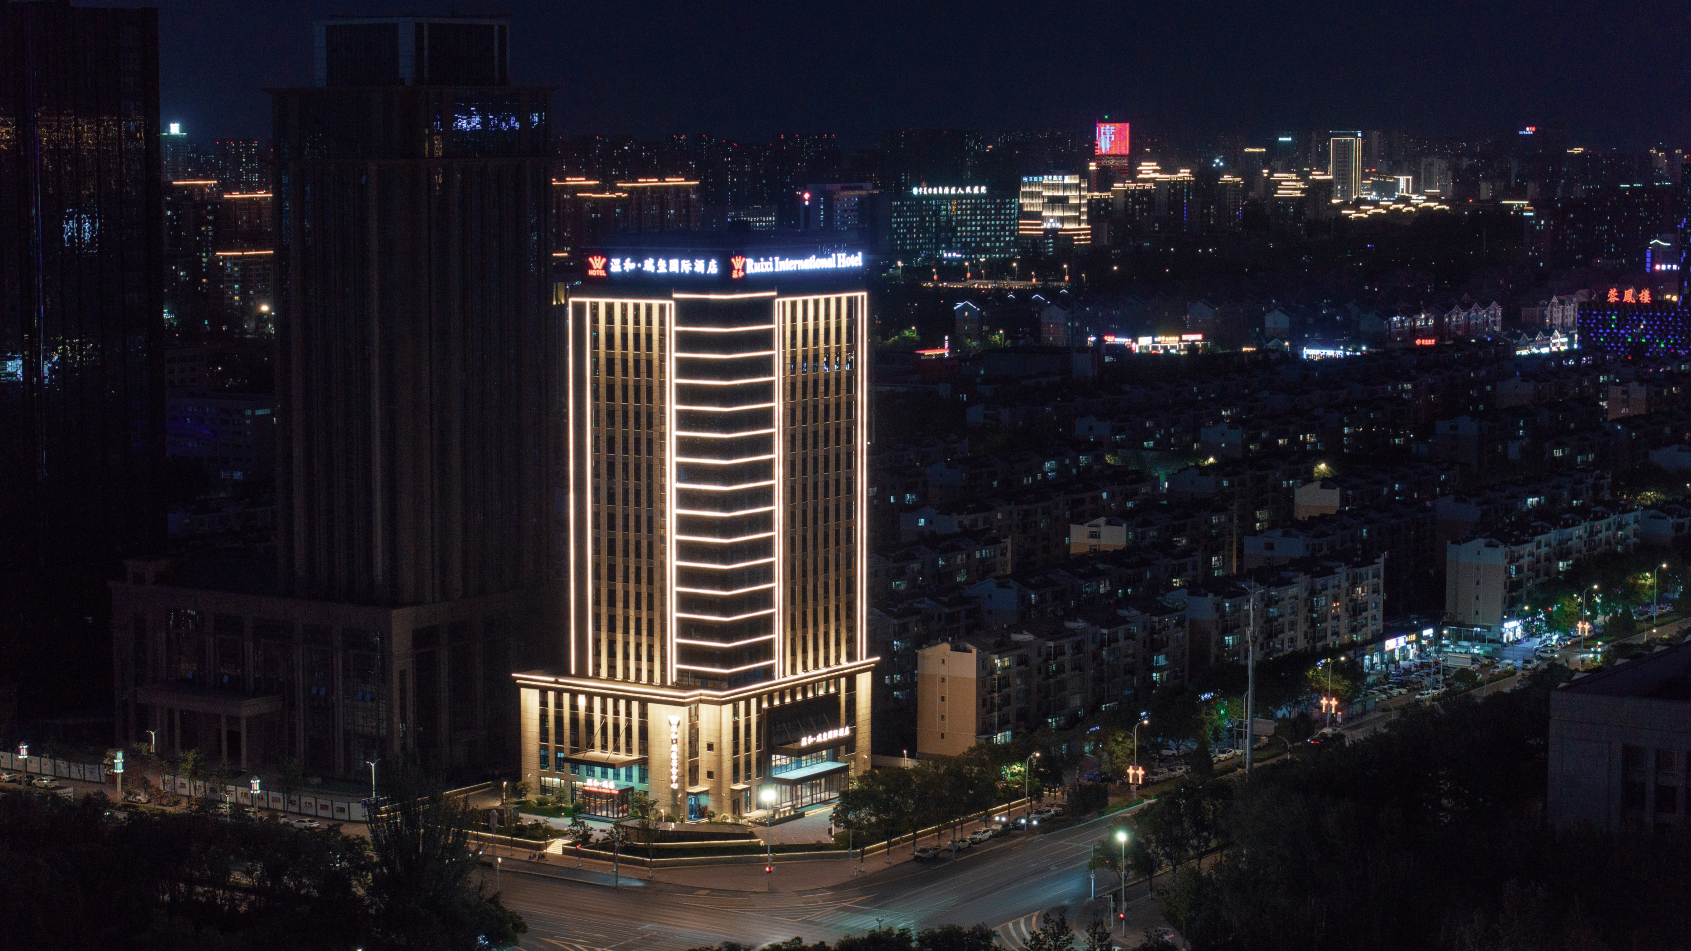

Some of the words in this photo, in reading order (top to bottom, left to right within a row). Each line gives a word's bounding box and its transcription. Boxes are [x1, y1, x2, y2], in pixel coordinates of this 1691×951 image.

[610, 257, 718, 274] 温和·瑞玺国际酒店
[746, 257, 774, 274] Ruixi
[774, 254, 836, 272] International
[837, 251, 863, 268] Hotel
